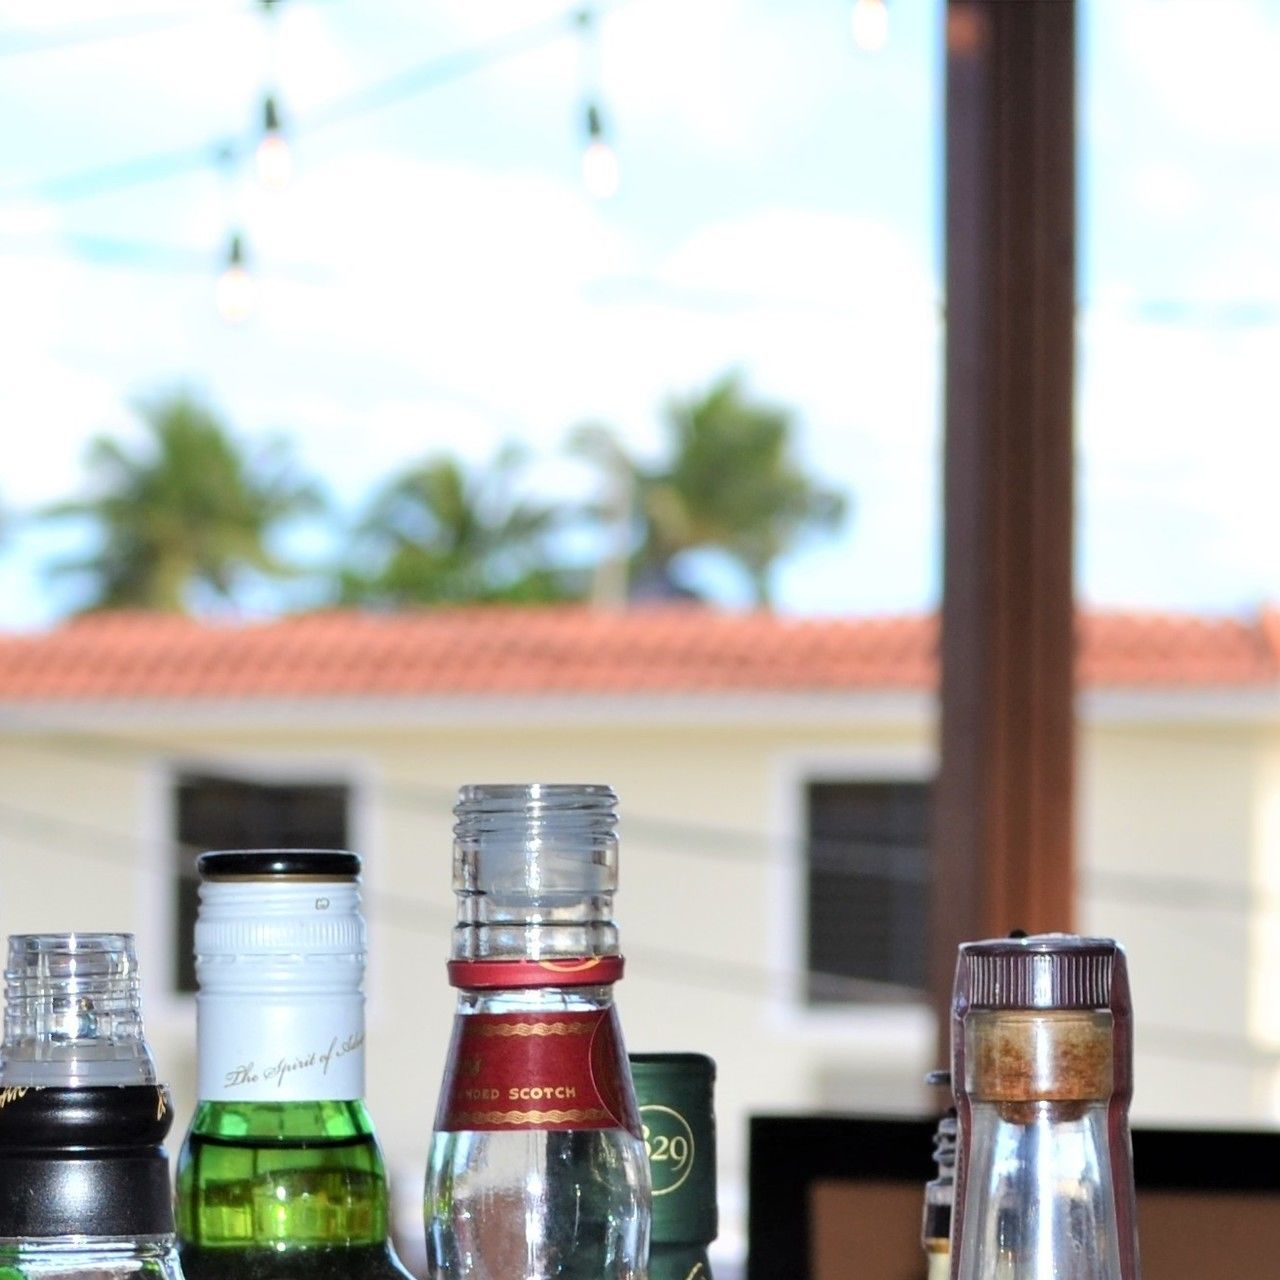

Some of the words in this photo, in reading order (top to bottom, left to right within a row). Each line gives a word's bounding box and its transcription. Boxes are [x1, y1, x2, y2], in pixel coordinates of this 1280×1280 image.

[224, 1062, 259, 1088] The
[263, 1053, 316, 1088] Spirit
[319, 1036, 338, 1076] of
[509, 1087, 576, 1100] SCOTCH
